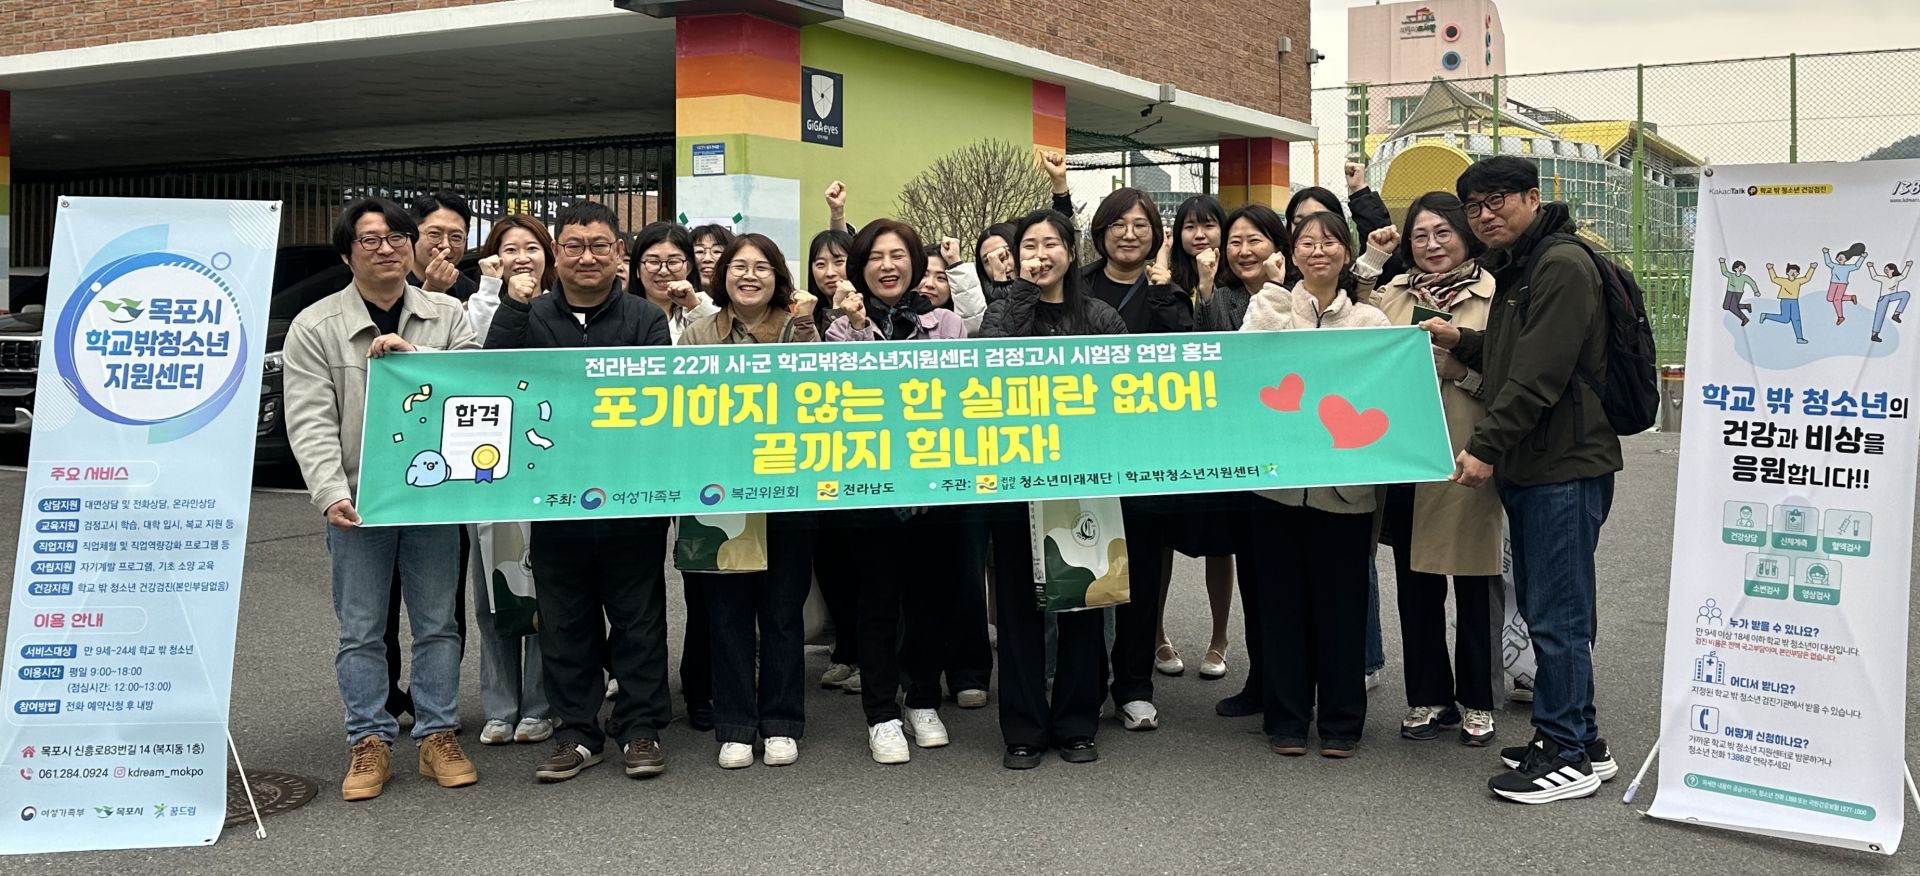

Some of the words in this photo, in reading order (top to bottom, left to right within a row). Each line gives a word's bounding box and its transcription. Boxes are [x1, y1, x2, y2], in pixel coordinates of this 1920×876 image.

[1709, 187, 1745, 195] KakaoTalk
[148, 298, 222, 324] 목포시
[85, 329, 229, 357] 학교밖청소년
[585, 356, 666, 377] 전라남도
[672, 355, 720, 376] 22개
[778, 348, 979, 372] 학교밖청소년지원센터
[985, 346, 1065, 367] 검정고시
[1071, 345, 1130, 365] 시험장
[1137, 343, 1176, 364] 연합
[1182, 342, 1222, 362] 홍보
[104, 363, 204, 390] 지원센터
[591, 382, 778, 428] 포기하지
[794, 380, 884, 424] 않는
[899, 377, 946, 420] 한
[959, 373, 1098, 418] 실패란
[1111, 370, 1217, 414] 없어!
[1702, 384, 1756, 412] 학교
[1766, 387, 1793, 414] 밖
[1802, 388, 1908, 419] 청소년의
[455, 404, 499, 427] 합격
[1723, 420, 1798, 449] 건강과
[1805, 425, 1885, 455] 비상을
[753, 429, 891, 475] 끝까지
[906, 423, 1060, 469] 힘내자!
[50, 467, 80, 481] 주요
[84, 467, 128, 480] 서비스
[1020, 471, 1112, 488] 청소년미래재단
[1125, 465, 1260, 483] 학교밖청소년지원센터
[1732, 455, 1869, 489] 응원합니다!!
[941, 479, 971, 491] 주관:
[545, 494, 576, 507] 주최:
[612, 489, 680, 505] 여성가족부
[731, 485, 799, 500] 복권위원회
[843, 482, 895, 496] 전라남도
[42, 500, 78, 511] 상담지원
[85, 500, 118, 510] 대면상담
[122, 500, 130, 510] 및
[173, 499, 215, 509] 온라인상담
[41, 520, 76, 531] 교육지원
[84, 520, 117, 530] 검정고시
[144, 519, 160, 530] 대학
[186, 519, 202, 529] 복교
[205, 519, 222, 529] 지원
[226, 518, 233, 529] 등
[1731, 532, 1758, 543] 건강상담
[39, 541, 75, 552] 직업지원
[83, 541, 116, 551] 직업체험
[120, 540, 128, 551] 및
[131, 540, 182, 551] 직업역량강화
[184, 540, 218, 550] 프로그램
[222, 540, 229, 550] 등
[36, 562, 73, 573] 자립지원
[80, 562, 116, 572] 자기계발
[158, 561, 175, 571] 기초
[178, 561, 195, 571] 소양
[198, 561, 214, 571] 교육
[34, 583, 70, 594] 건강지원
[78, 583, 95, 593] 학교
[99, 582, 108, 593] 밖
[111, 582, 136, 593] 청소년
[1802, 590, 1831, 600] 영상검사
[34, 614, 65, 628] 이용
[71, 613, 104, 627] 안내
[1729, 618, 1748, 629] 누가
[1752, 620, 1770, 632] 받을
[1773, 623, 1781, 633] 수
[1785, 624, 1819, 637] 있나요?
[1718, 630, 1732, 640] 이상
[1767, 637, 1781, 646] 학교
[1782, 638, 1789, 647] 밖
[25, 646, 72, 657] 서비스대상
[84, 646, 93, 656] 만
[139, 645, 155, 655] 학교
[158, 645, 167, 655] 밖
[169, 645, 194, 655] 청소년
[23, 667, 61, 678] 이용시간
[69, 667, 87, 677] 평일
[1730, 676, 1758, 689] 어디서
[1762, 680, 1795, 695] 받나요?
[19, 701, 59, 712] 참여방법
[66, 701, 84, 712] 전화
[87, 701, 124, 711] 예약신청
[126, 700, 134, 711] 후
[137, 700, 153, 711] 내방
[1691, 685, 1714, 697] 지정된
[1715, 688, 1730, 700] 학교
[1731, 690, 1739, 701] 밖
[1740, 692, 1761, 705] 청소년
[1805, 701, 1820, 713] 받을
[1822, 704, 1829, 715] 수
[1725, 726, 1753, 740] 어떻게
[1756, 731, 1809, 749] 신청하나요?
[41, 746, 71, 757] 목포시
[75, 745, 136, 757] 신흥로83번길
[140, 745, 150, 754] 14
[153, 744, 183, 755] (복지동
[187, 743, 205, 754] 1층)
[1712, 738, 1726, 749] 학교
[1728, 740, 1735, 751] 밖
[1736, 742, 1757, 755] 청소년
[1688, 745, 1709, 757] 청소년
[1711, 749, 1726, 759] 전화
[1727, 751, 1752, 764] 1388로
[38, 768, 108, 779] 061.284.0924
[128, 767, 204, 779] kdream_mokpo
[41, 808, 85, 818] 여성가족부
[116, 807, 143, 816] 목포시
[170, 806, 196, 816] 꿈드림
